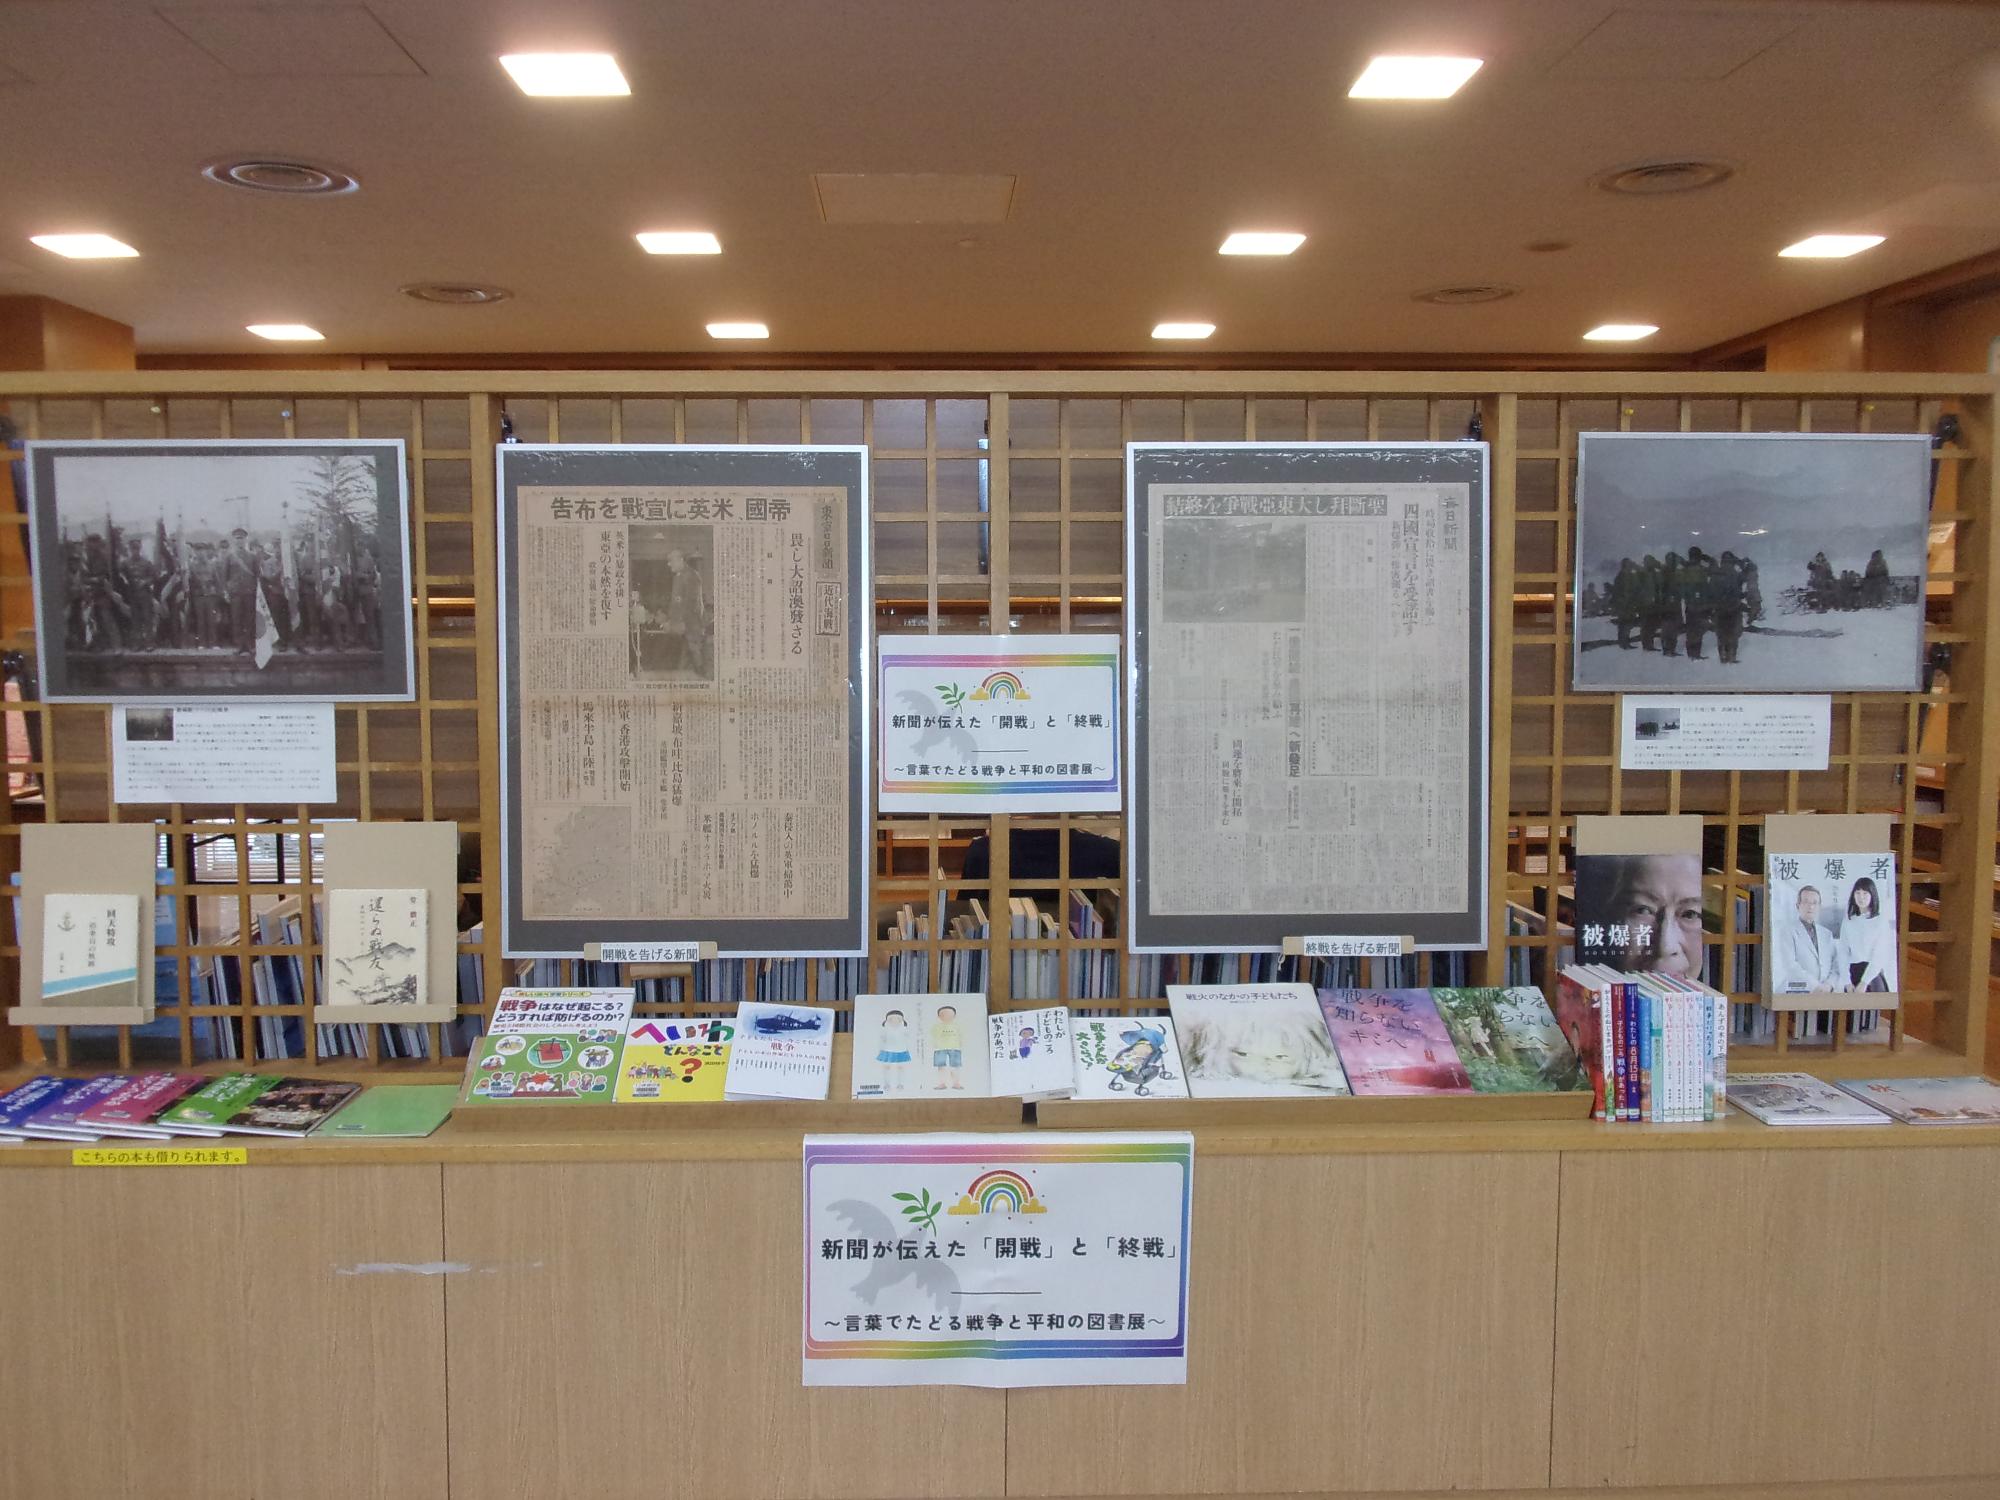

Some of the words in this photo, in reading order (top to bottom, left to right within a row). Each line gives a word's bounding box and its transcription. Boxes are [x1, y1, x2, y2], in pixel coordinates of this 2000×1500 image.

[892, 714, 1112, 729] 新聞が伝えた「開戦」と「終戦」
[1779, 858, 1890, 880] 被爆者
[1582, 924, 1654, 947] 被爆者
[602, 948, 698, 960] 開戦を告げる新聞
[1305, 942, 1400, 956] 終戦を告げる新聞
[1185, 992, 1298, 1000] 戦火のなかの子どもたち
[1340, 989, 1413, 1012] 戦争を
[1054, 1010, 1066, 1039] わたしが
[1335, 1006, 1421, 1031] 知らない
[991, 1016, 1004, 1059] 戦争があった
[1043, 1011, 1054, 1055] 子どものころ
[1350, 1029, 1408, 1049] キミへ
[770, 1042, 795, 1052] 戦争
[80, 1151, 240, 1163] こちらの本も借りられます。
[821, 1236, 1177, 1260] 新聞が伝えた「開戦」と「終戦」
